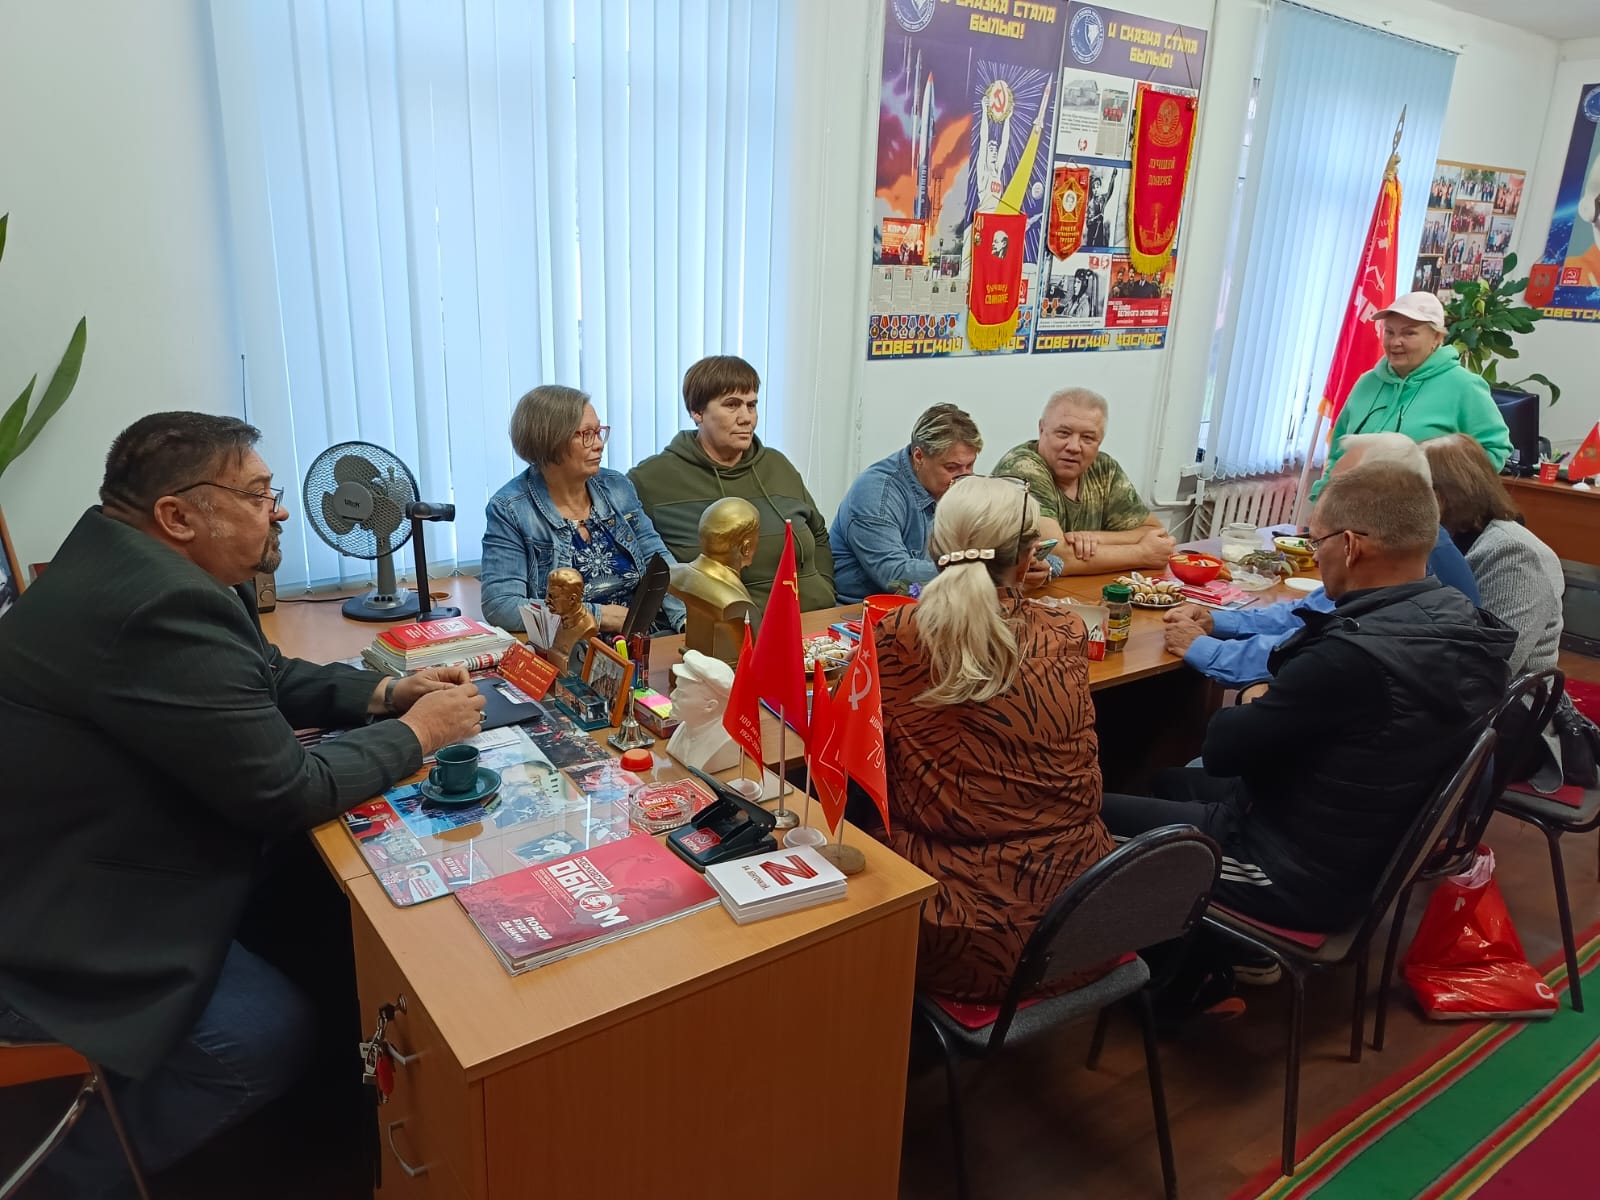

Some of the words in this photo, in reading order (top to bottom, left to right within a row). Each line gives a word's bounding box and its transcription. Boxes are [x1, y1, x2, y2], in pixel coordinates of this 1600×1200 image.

[1013, 1, 1057, 24] СТАЛА
[969, 13, 1025, 39] БЫЛЬЮ!
[1107, 21, 1117, 39] И
[1120, 24, 1162, 47] СКАЗКА
[1164, 34, 1198, 54] СТАЛА
[1129, 47, 1174, 69] БЫЛЬЮ!
[872, 336, 963, 356] СОВЕТСКИЙ
[1035, 333, 1111, 350] СОВЕТСКИЙ
[1115, 333, 1163, 345] КОСМОС
[574, 856, 614, 890] МОСКОВСКИЙ
[759, 854, 819, 887] Z
[547, 860, 630, 928] ОБКОМ
[524, 916, 553, 940] ПОБЕДА
